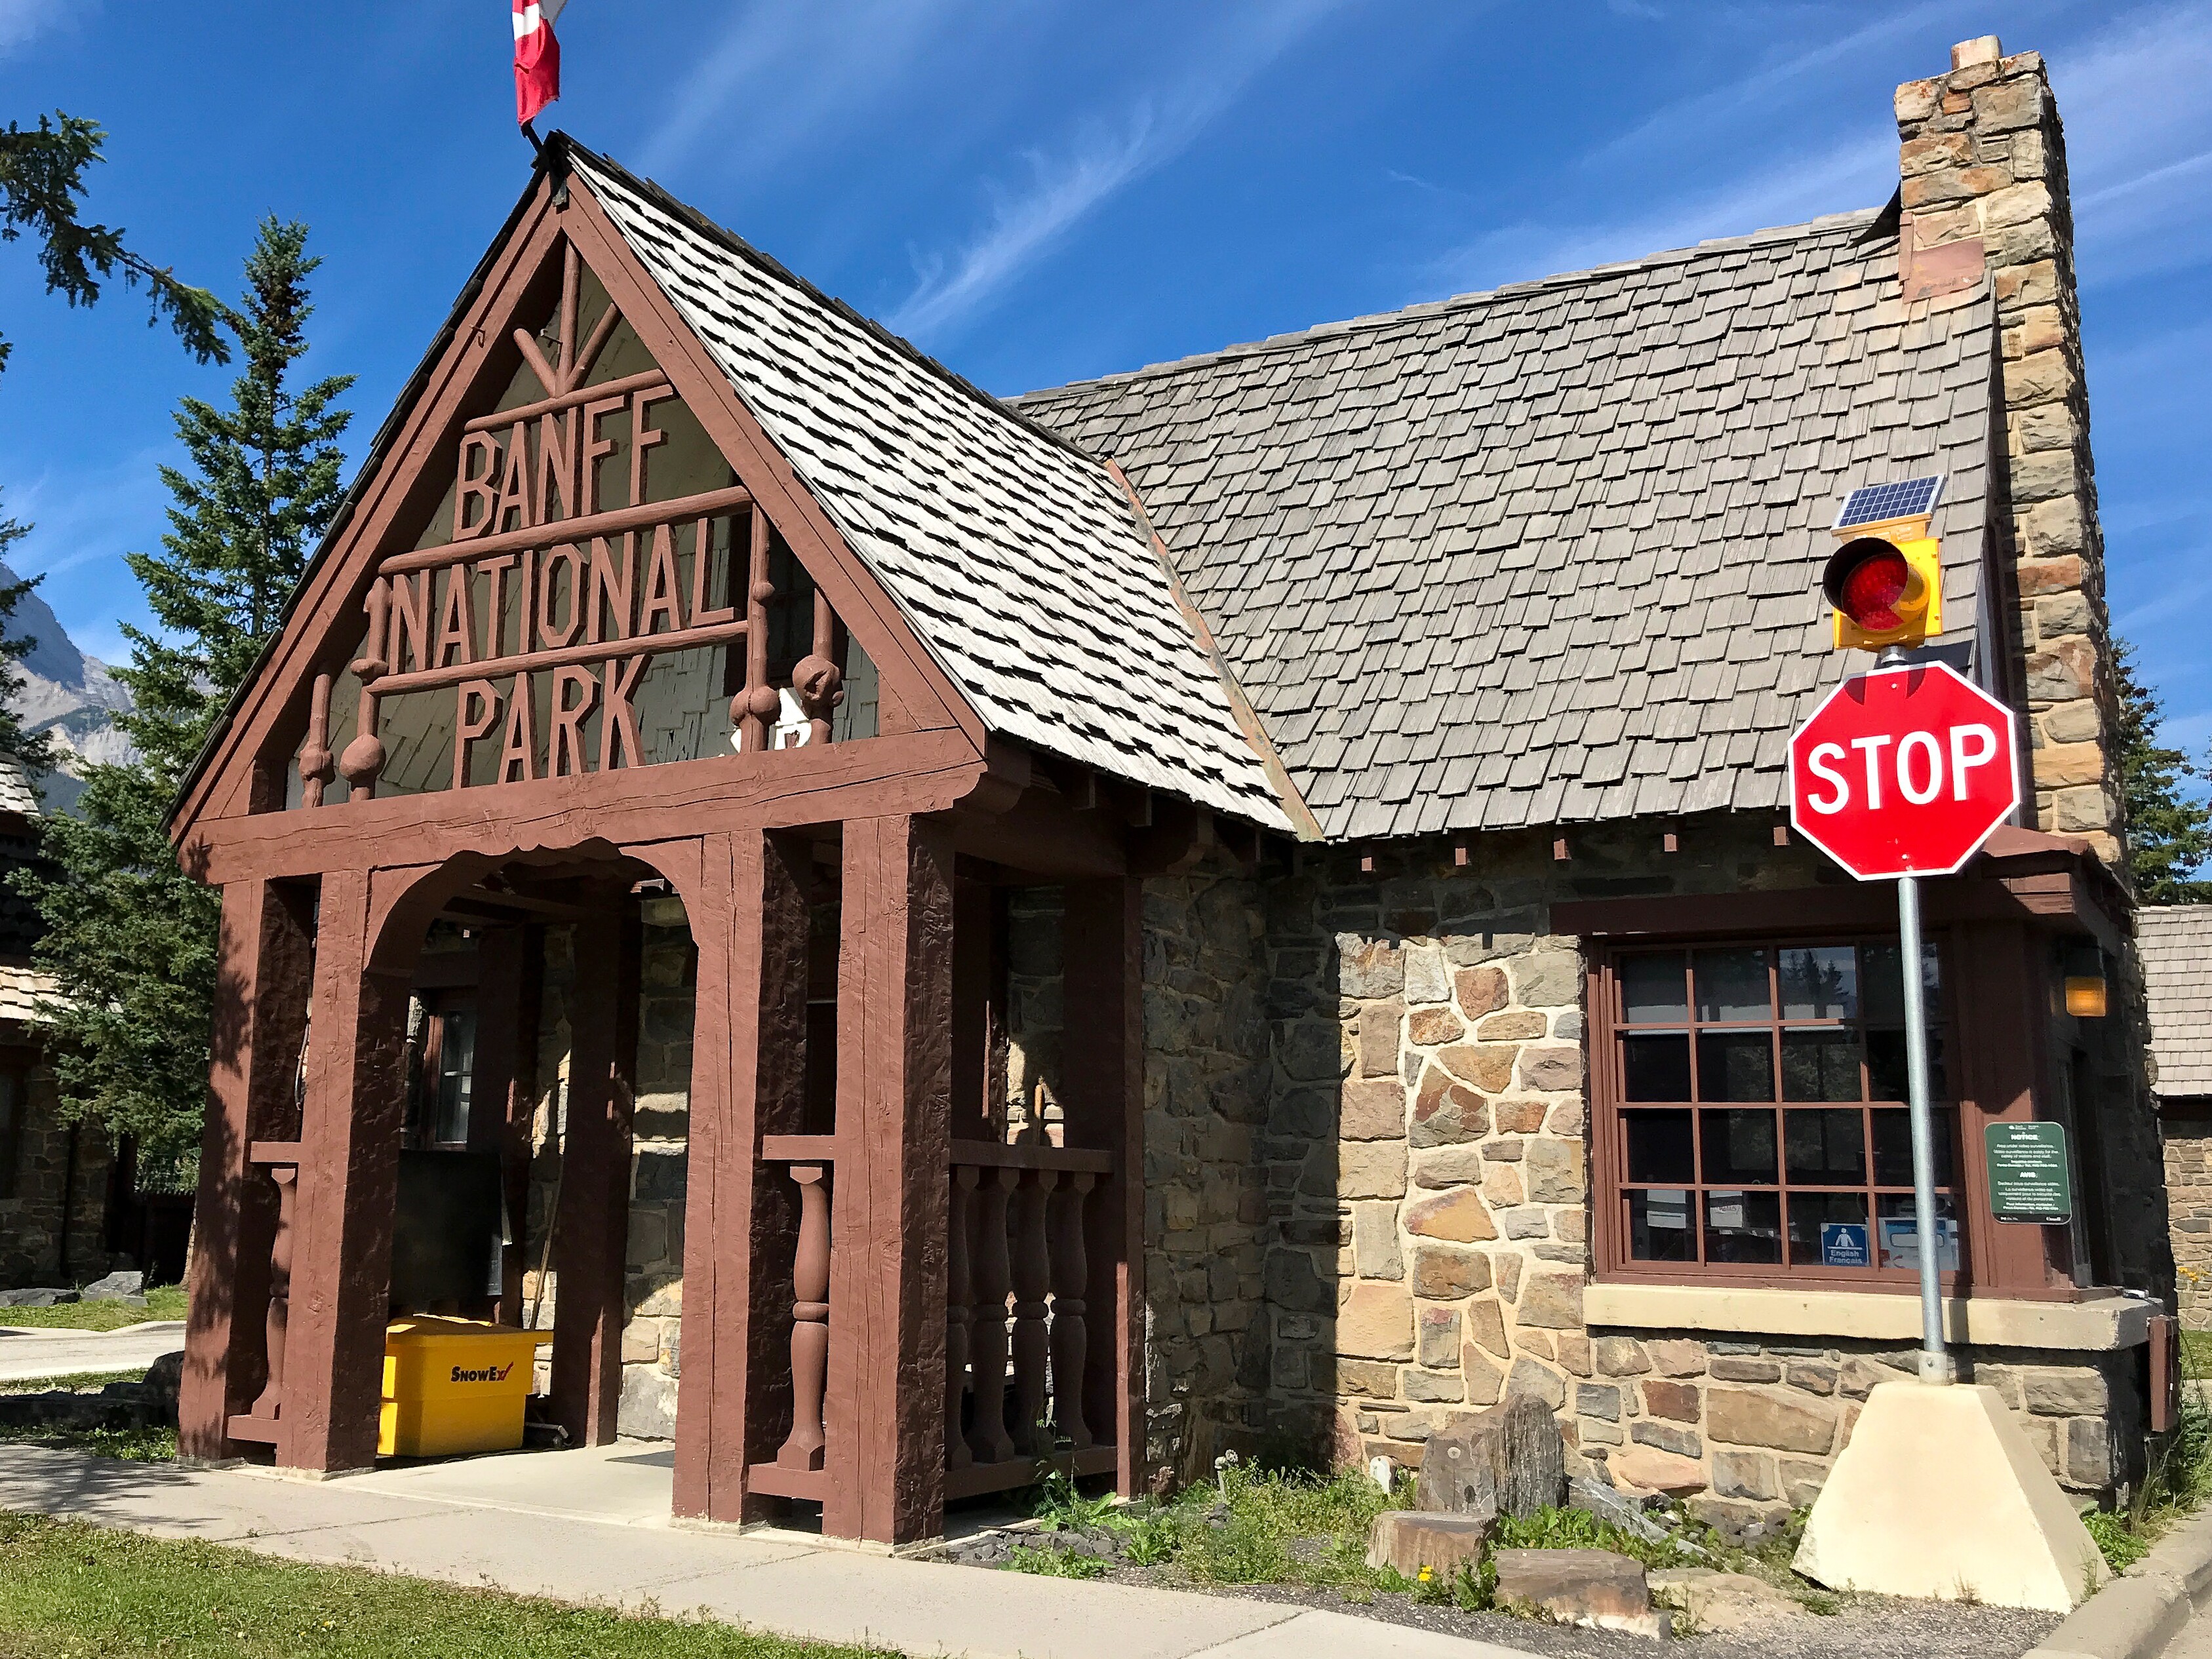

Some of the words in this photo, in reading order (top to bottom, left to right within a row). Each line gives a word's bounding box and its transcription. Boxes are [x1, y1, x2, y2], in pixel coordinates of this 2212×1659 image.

[452, 384, 673, 542] BANFF
[389, 517, 736, 675] NATIONAL
[452, 654, 646, 789] PARK
[1807, 723, 1997, 815] STOP
